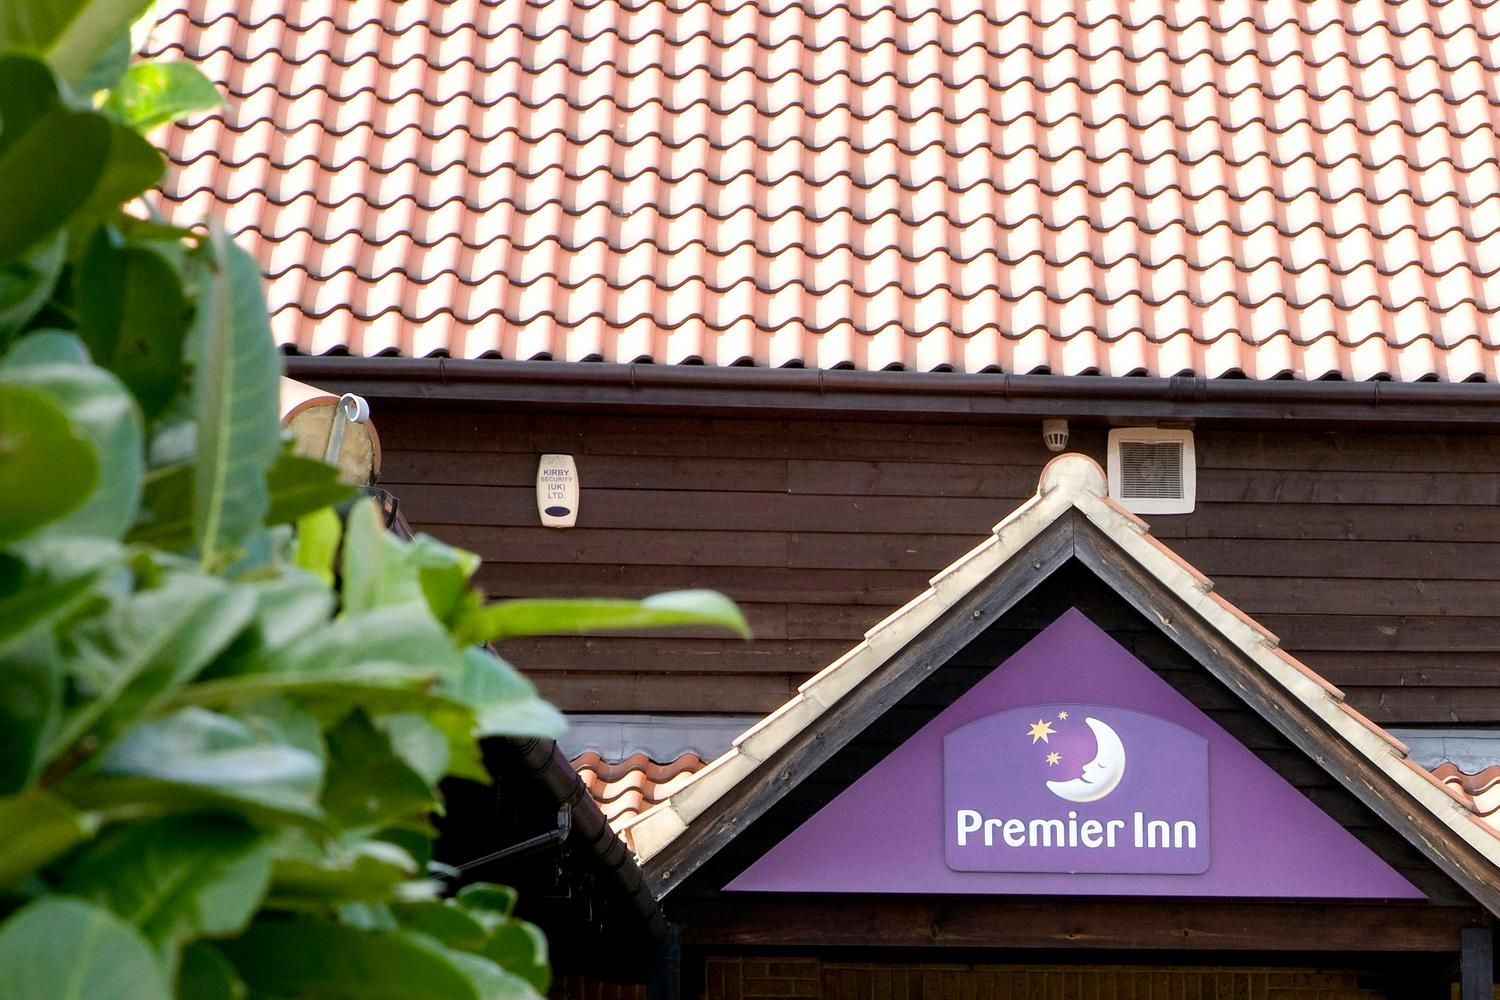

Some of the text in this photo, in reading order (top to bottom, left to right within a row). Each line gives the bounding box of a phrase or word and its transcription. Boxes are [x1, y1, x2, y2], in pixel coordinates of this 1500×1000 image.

[547, 483, 566, 491] (UK)
[956, 809, 1197, 849] Premier Inn
